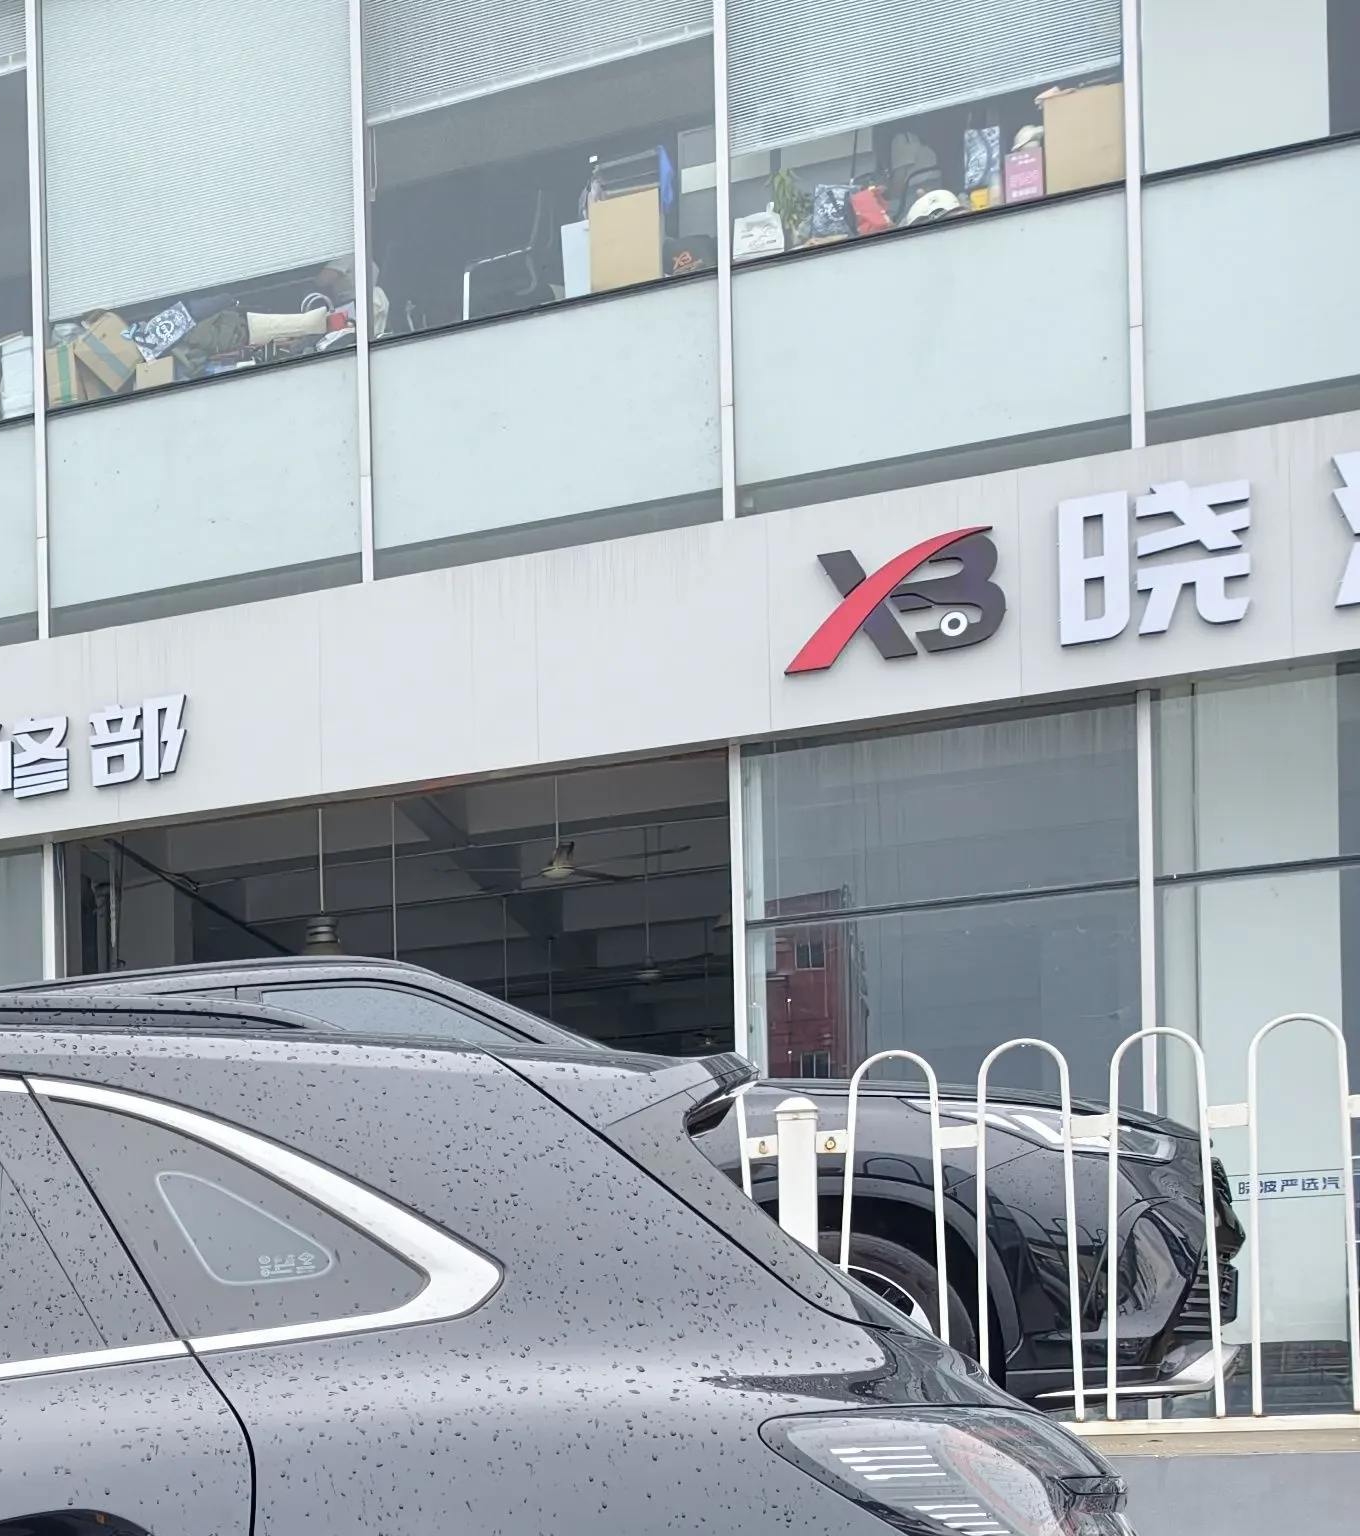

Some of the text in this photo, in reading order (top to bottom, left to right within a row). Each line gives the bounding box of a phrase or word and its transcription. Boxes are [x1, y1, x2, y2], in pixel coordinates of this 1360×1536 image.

[1058, 450, 1360, 647] 晓
[1238, 1175, 1346, 1195] 晓波严选汽
